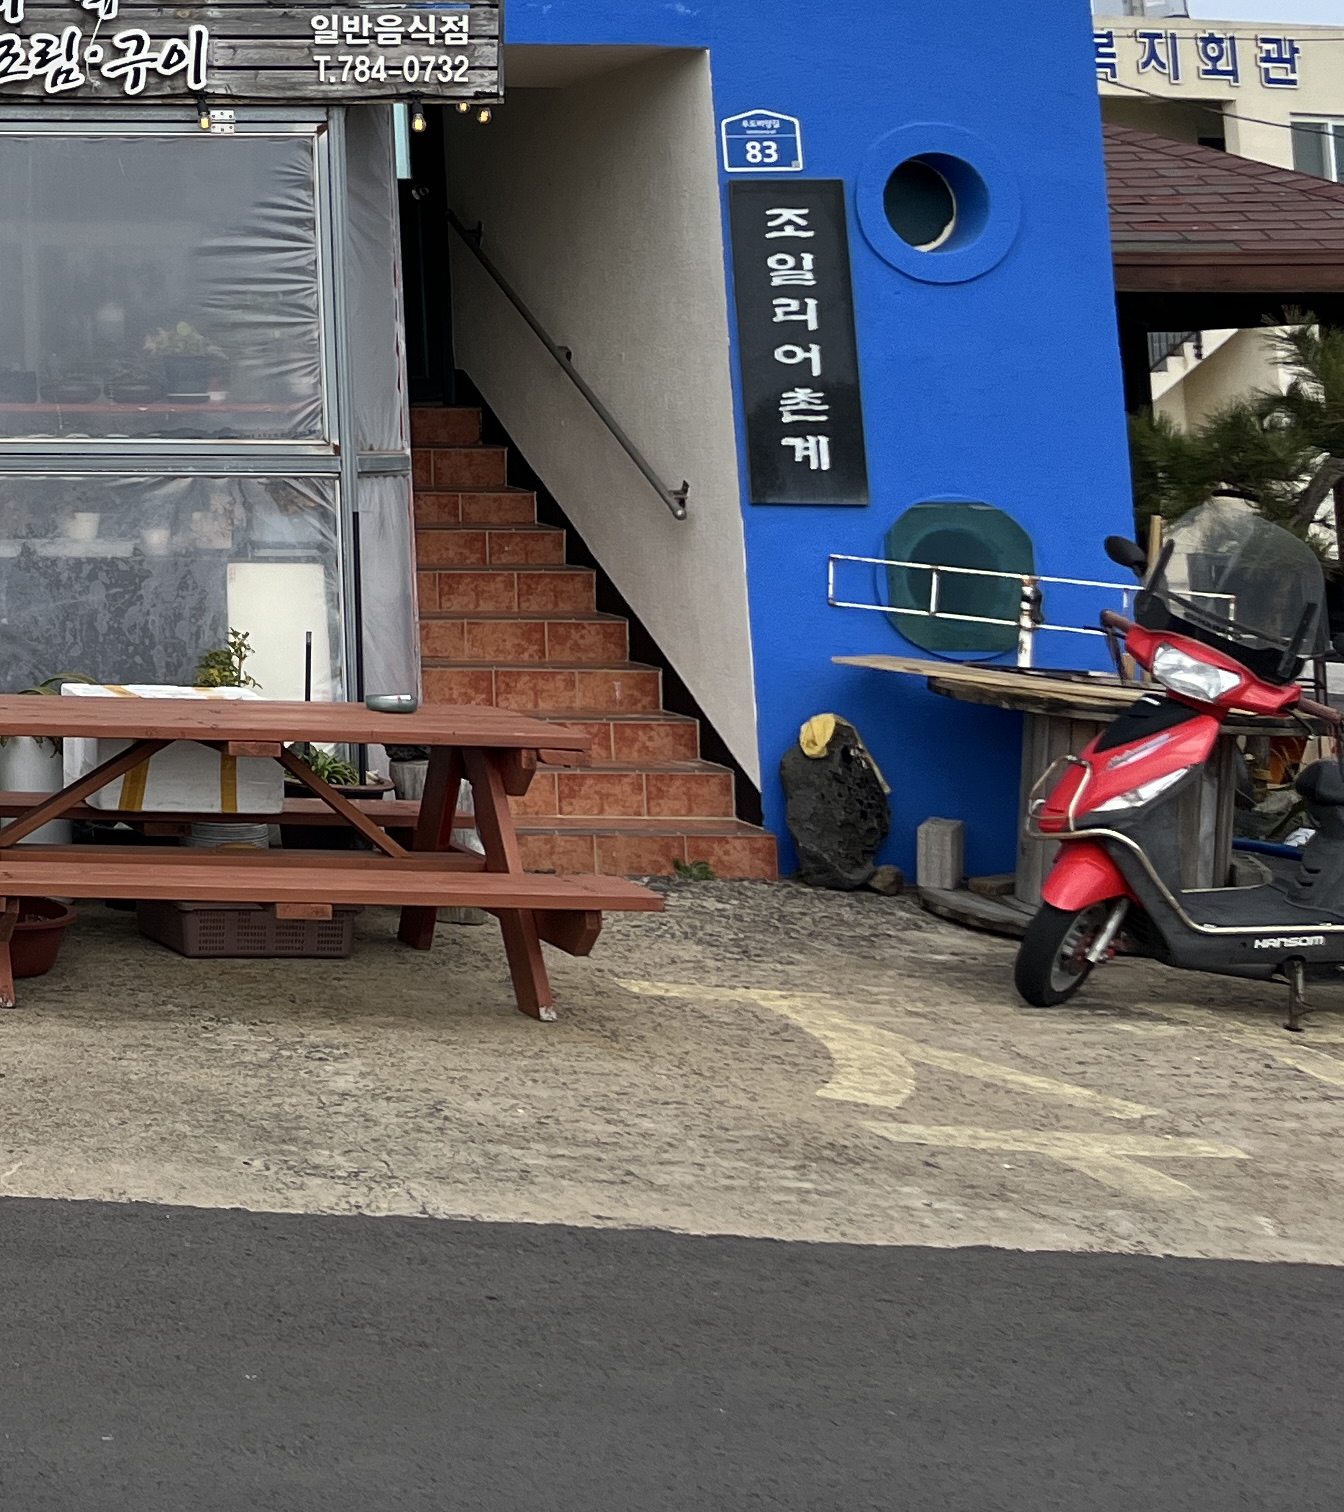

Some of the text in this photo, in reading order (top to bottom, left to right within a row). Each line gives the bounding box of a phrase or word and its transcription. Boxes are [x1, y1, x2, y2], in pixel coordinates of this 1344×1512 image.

[310, 14, 469, 45] 일반음식점
[313, 55, 469, 83] T.784-0732
[745, 140, 779, 164] 83
[765, 207, 831, 471] 조일리어촌계
